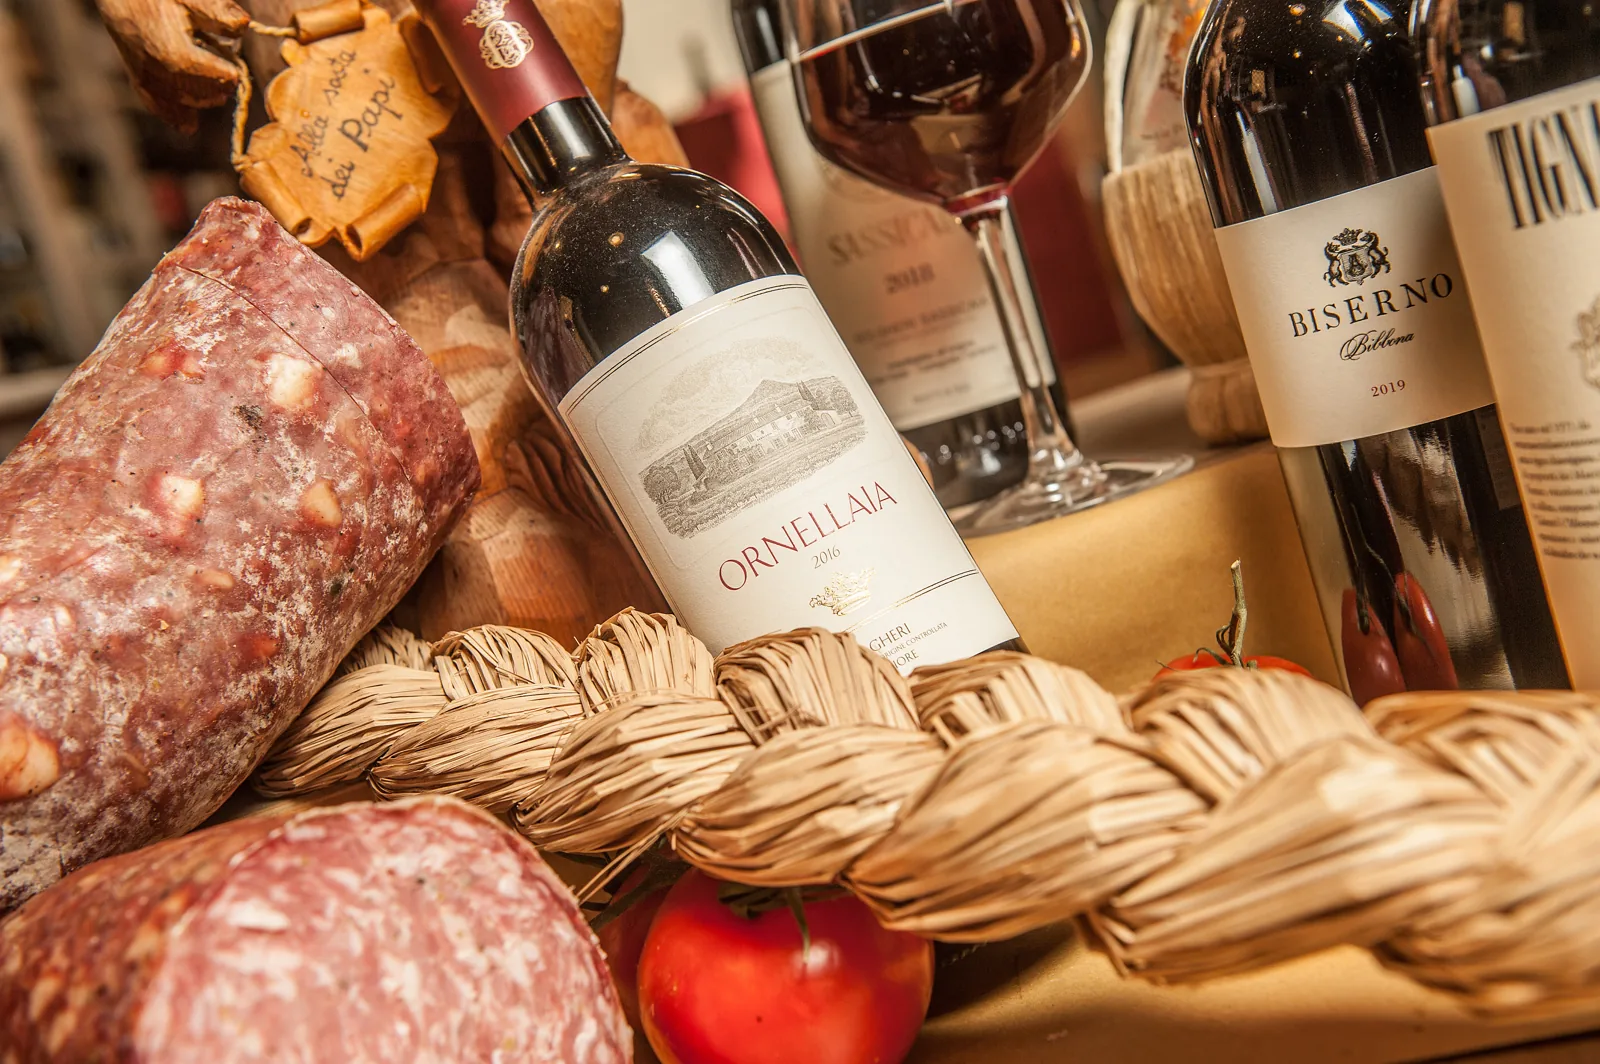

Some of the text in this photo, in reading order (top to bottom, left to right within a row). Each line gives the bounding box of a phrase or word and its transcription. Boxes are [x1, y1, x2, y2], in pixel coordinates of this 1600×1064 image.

[290, 50, 357, 178] Alla sosta
[319, 67, 403, 201] dei Papi
[1486, 100, 1600, 231] TIGN
[1288, 273, 1453, 338] BISERNO
[1340, 328, 1416, 361] Bibbona
[1371, 379, 1406, 397] 2019
[718, 481, 898, 591] ORNELLAIA
[811, 545, 842, 570] 2016
[869, 623, 912, 652] GHERI
[906, 622, 948, 647] CONTROLLATA
[892, 649, 920, 669] IORE
